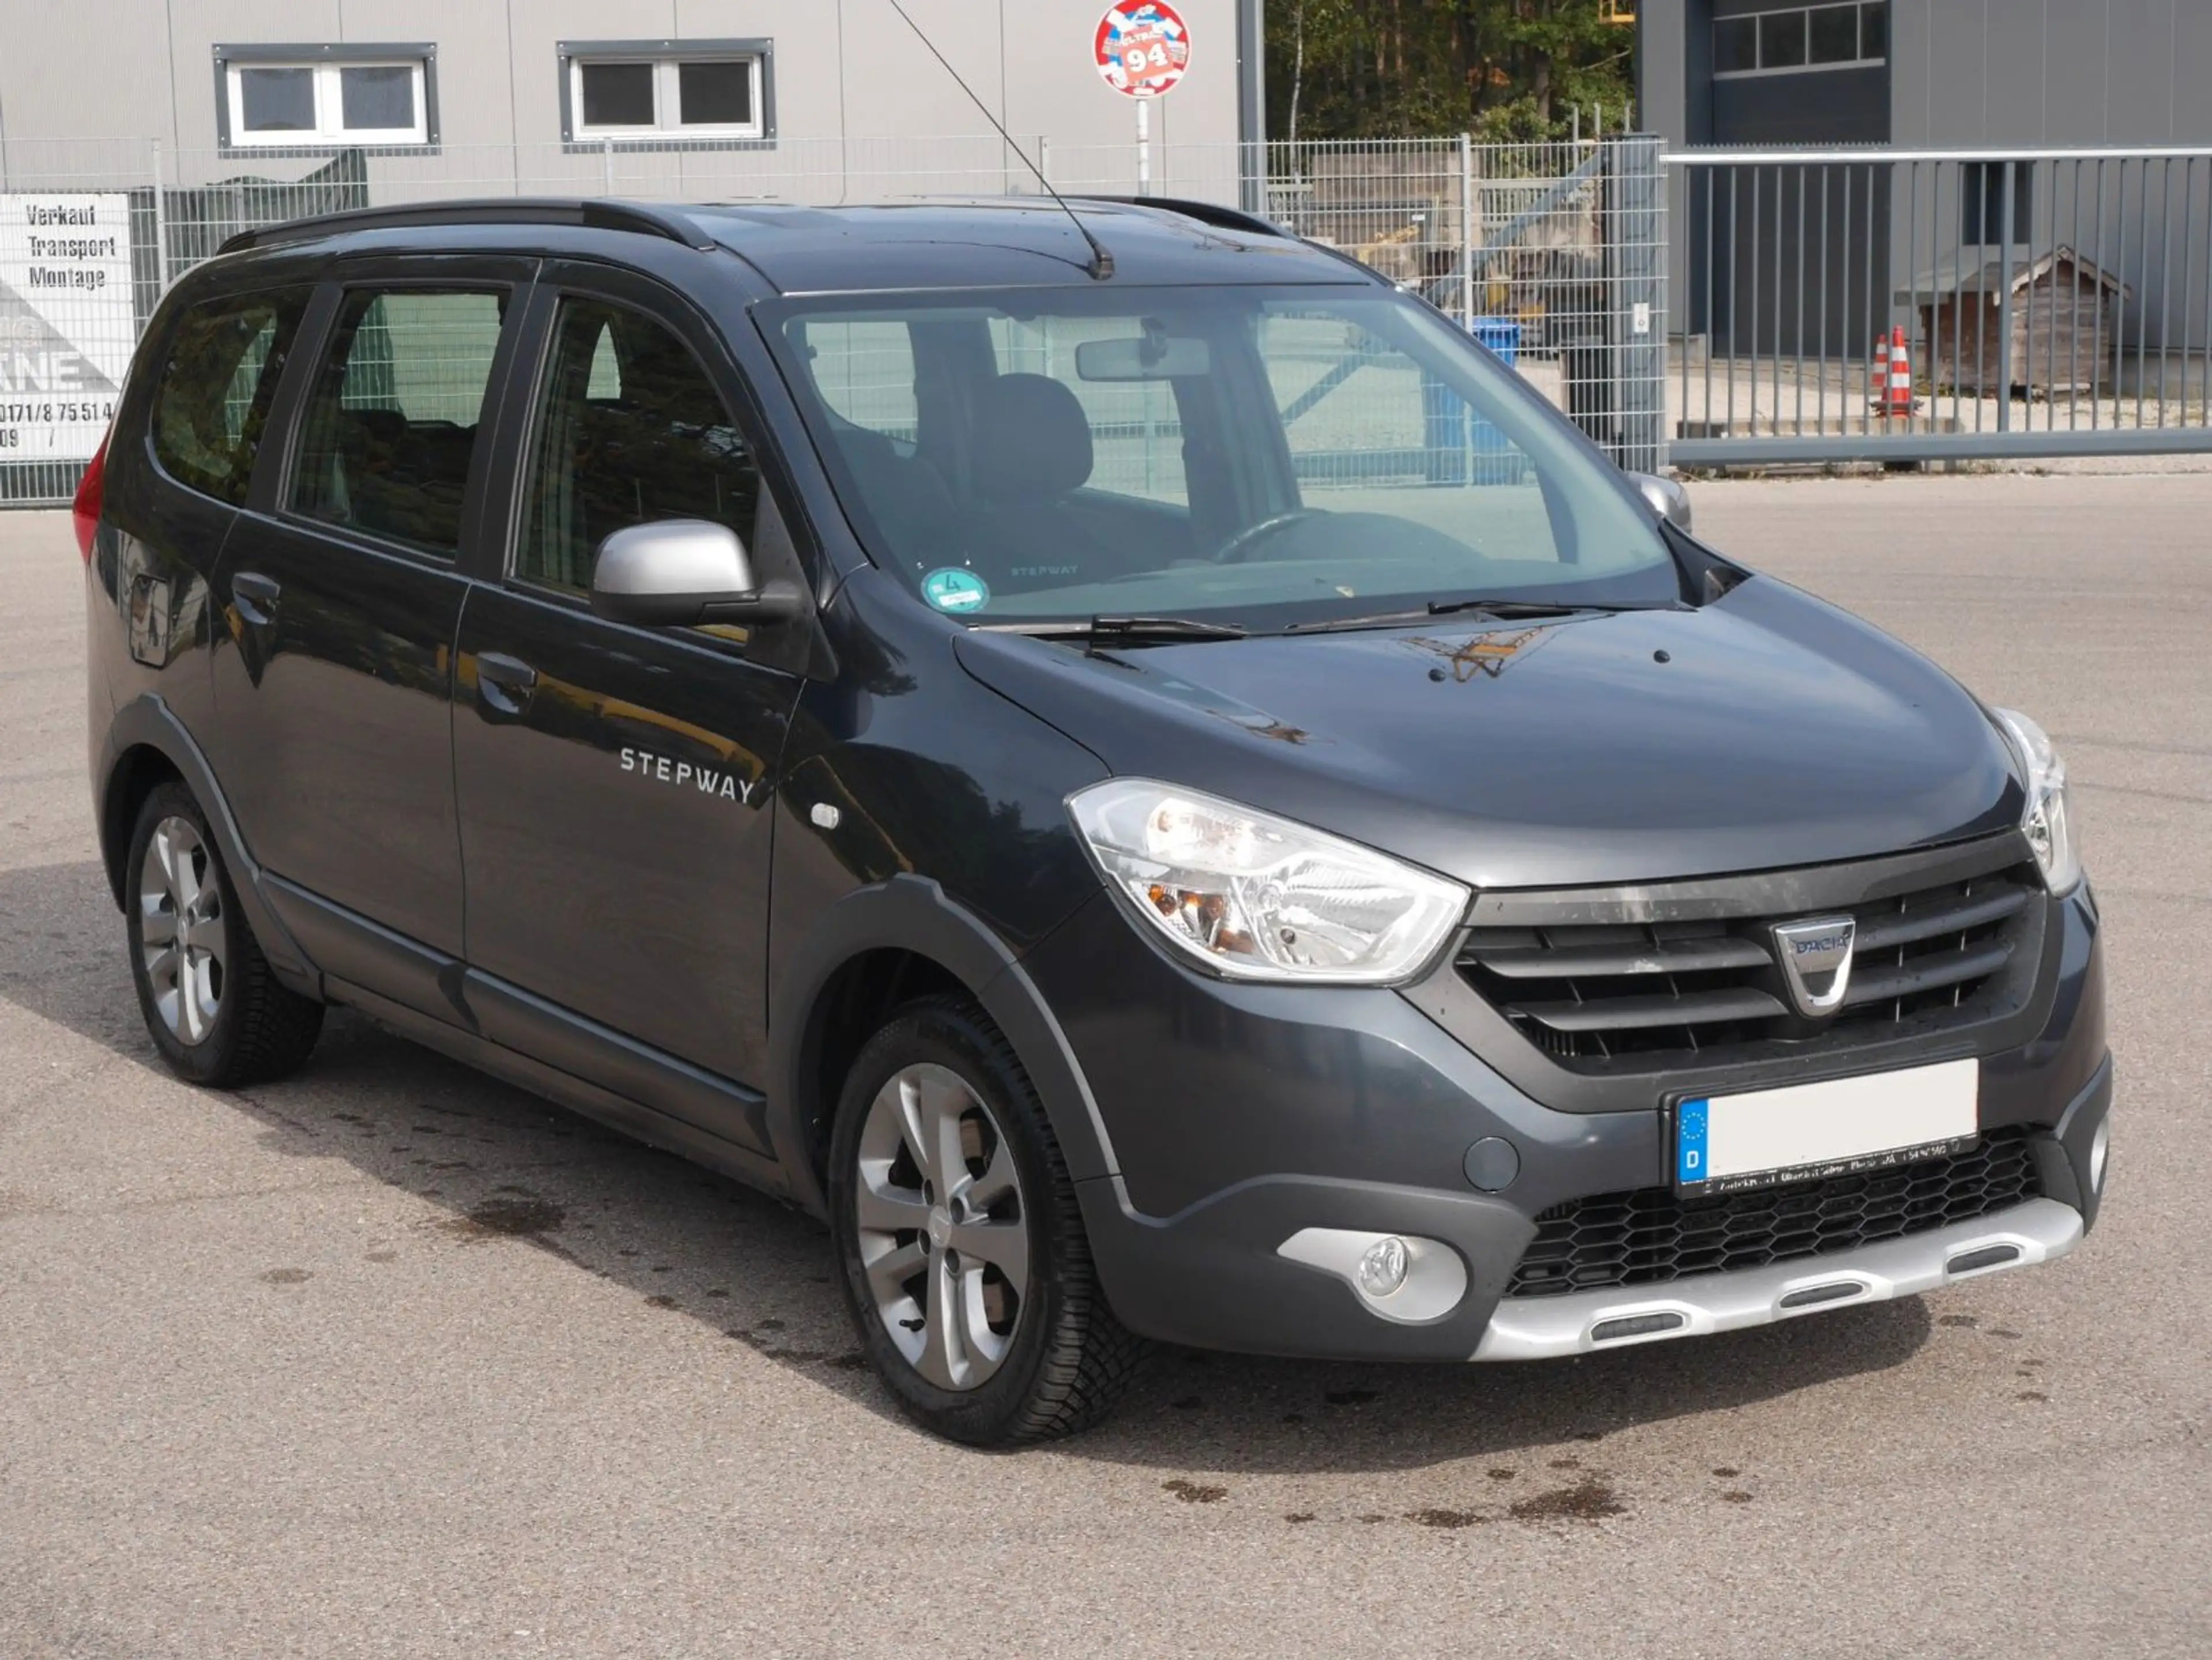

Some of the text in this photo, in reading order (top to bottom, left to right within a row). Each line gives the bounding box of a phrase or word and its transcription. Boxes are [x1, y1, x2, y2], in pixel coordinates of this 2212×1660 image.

[1127, 43, 1168, 73] 94
[26, 204, 96, 225] Verkauf
[28, 236, 116, 261] Transport
[29, 267, 105, 291] Montage
[1011, 565, 1079, 576] STEPWAY
[946, 574, 961, 590] 4
[620, 747, 754, 805] STEPWAY
[1796, 935, 1848, 954] DACIA
[1686, 1150, 1699, 1169] D
